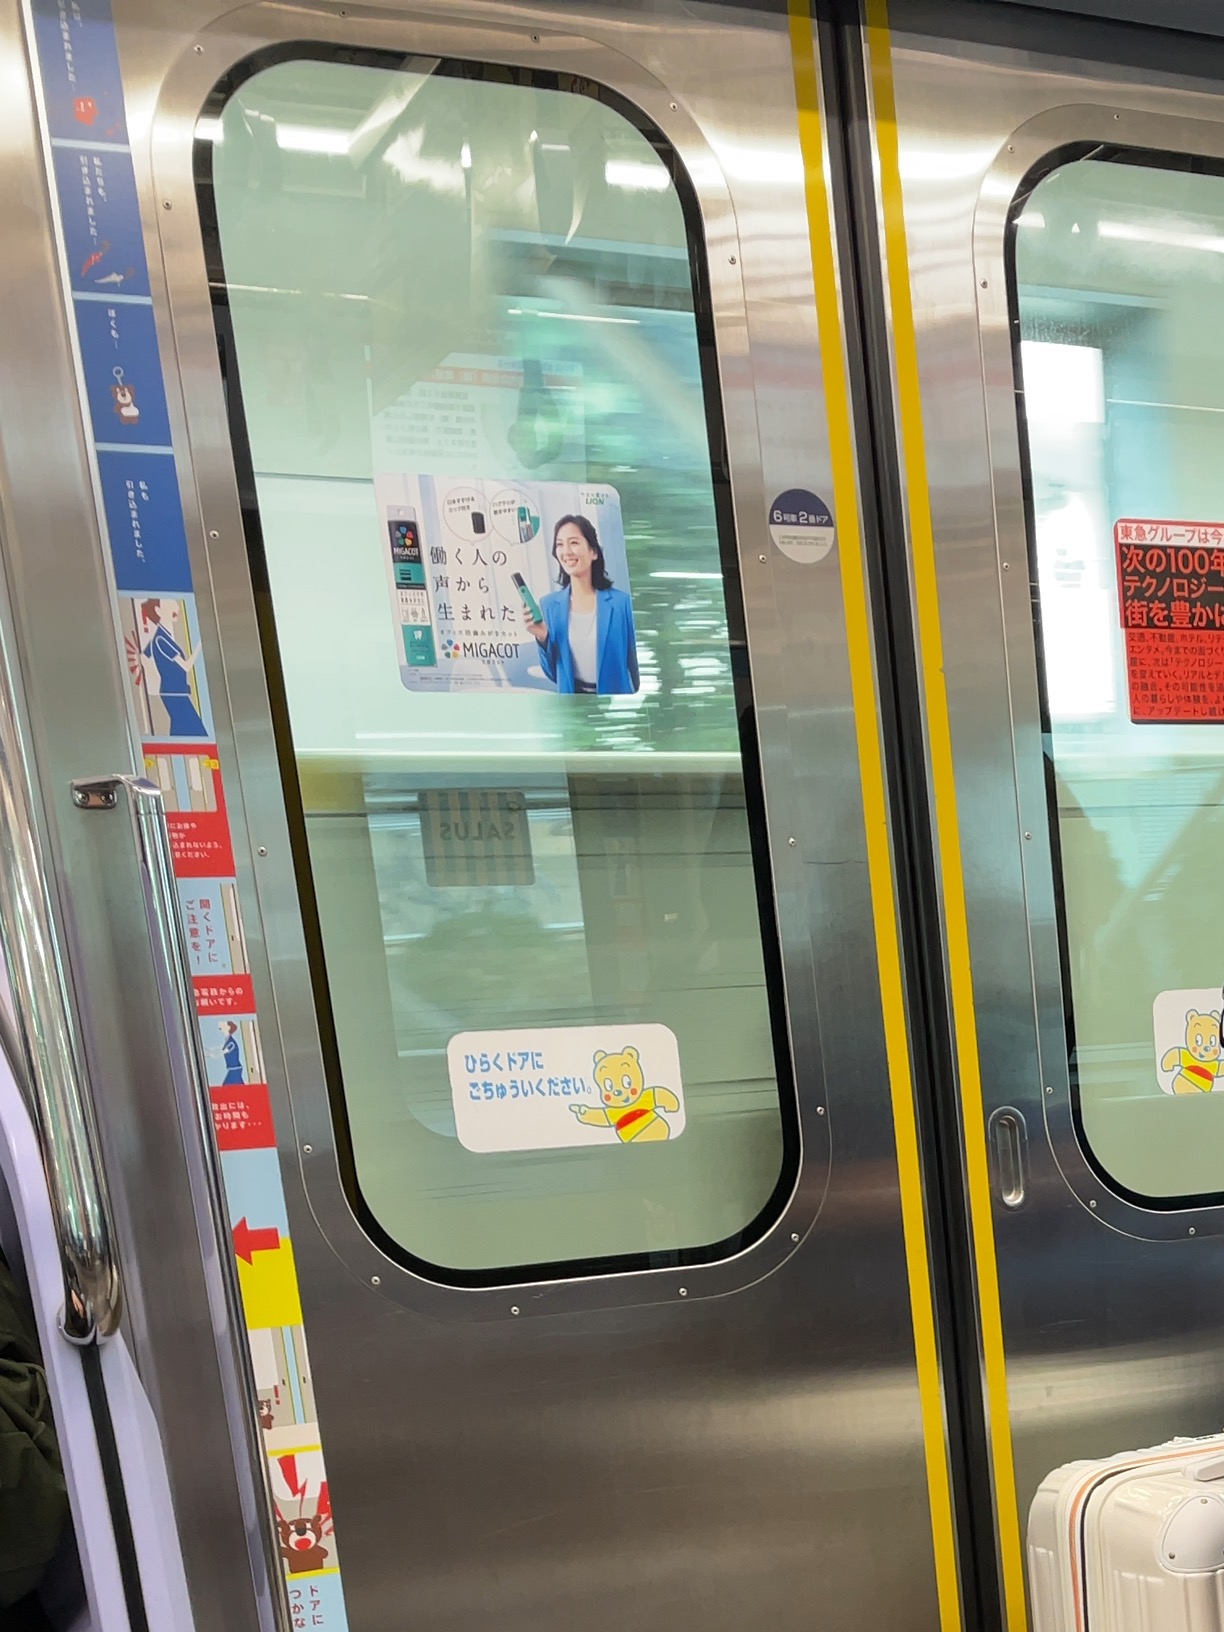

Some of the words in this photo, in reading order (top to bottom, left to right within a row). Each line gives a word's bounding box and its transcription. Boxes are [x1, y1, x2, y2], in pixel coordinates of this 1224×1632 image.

[430, 546, 507, 566] 働く人の
[433, 575, 491, 594] 声から
[437, 602, 516, 622] 生まれた
[462, 642, 520, 658] MIGACOT
[199, 898, 219, 963] 開くドアに
[464, 1050, 545, 1074] ひらくドアに
[468, 1076, 593, 1101] ごちゅういください。
